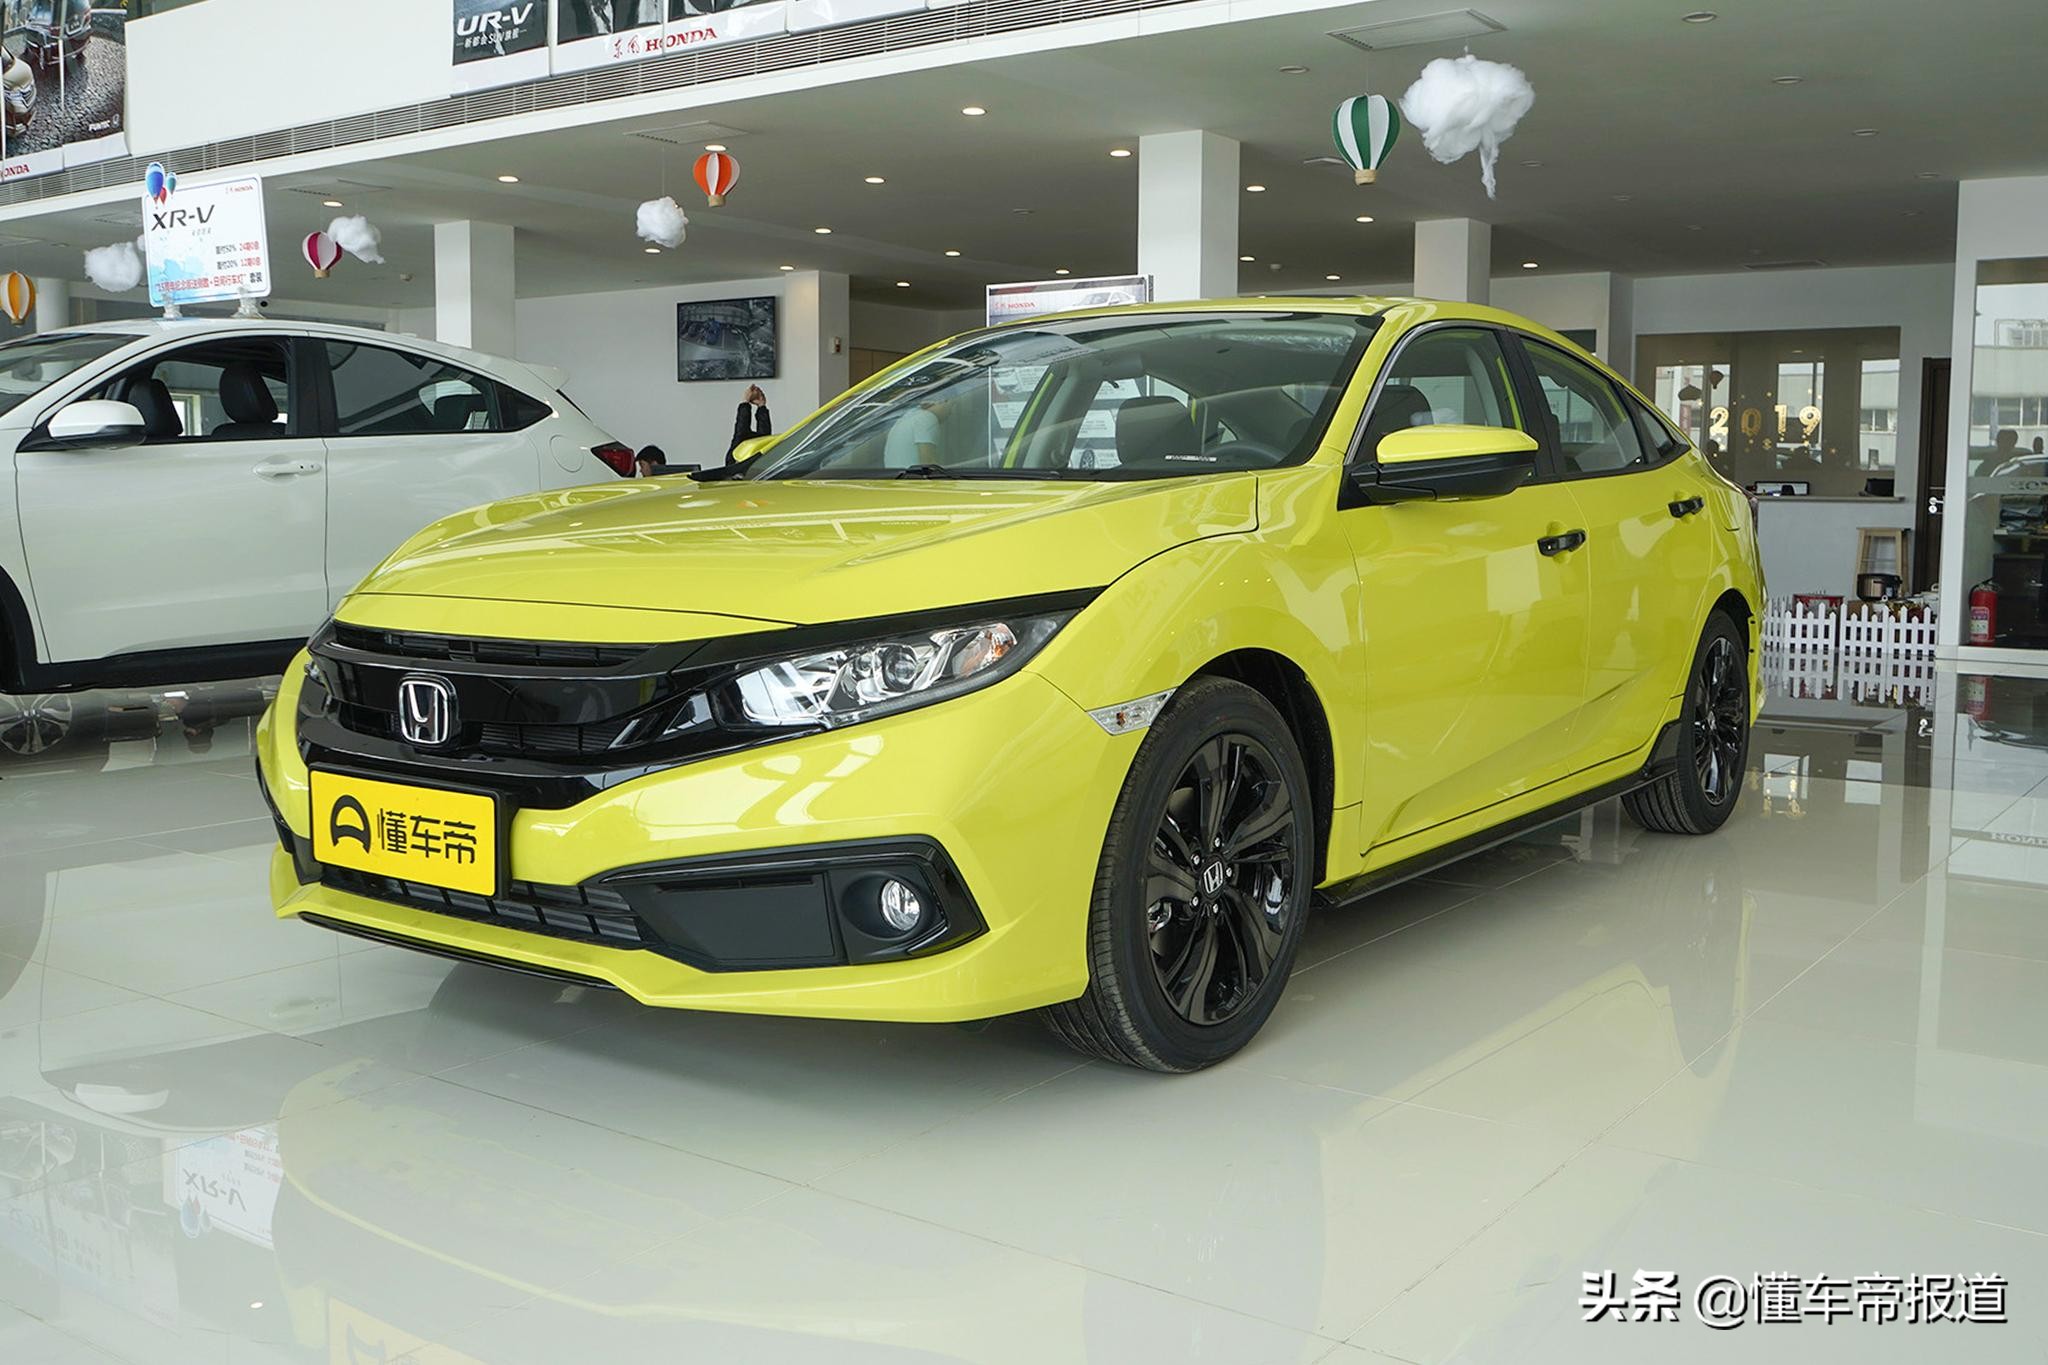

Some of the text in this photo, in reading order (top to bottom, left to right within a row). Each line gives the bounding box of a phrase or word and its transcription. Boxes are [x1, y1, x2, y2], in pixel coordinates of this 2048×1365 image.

[456, 2, 534, 36] UR-V
[645, 27, 717, 52] HONDA
[151, 204, 215, 231] XR-V
[1709, 404, 1822, 437] 2019
[376, 808, 477, 865] 懂车帝
